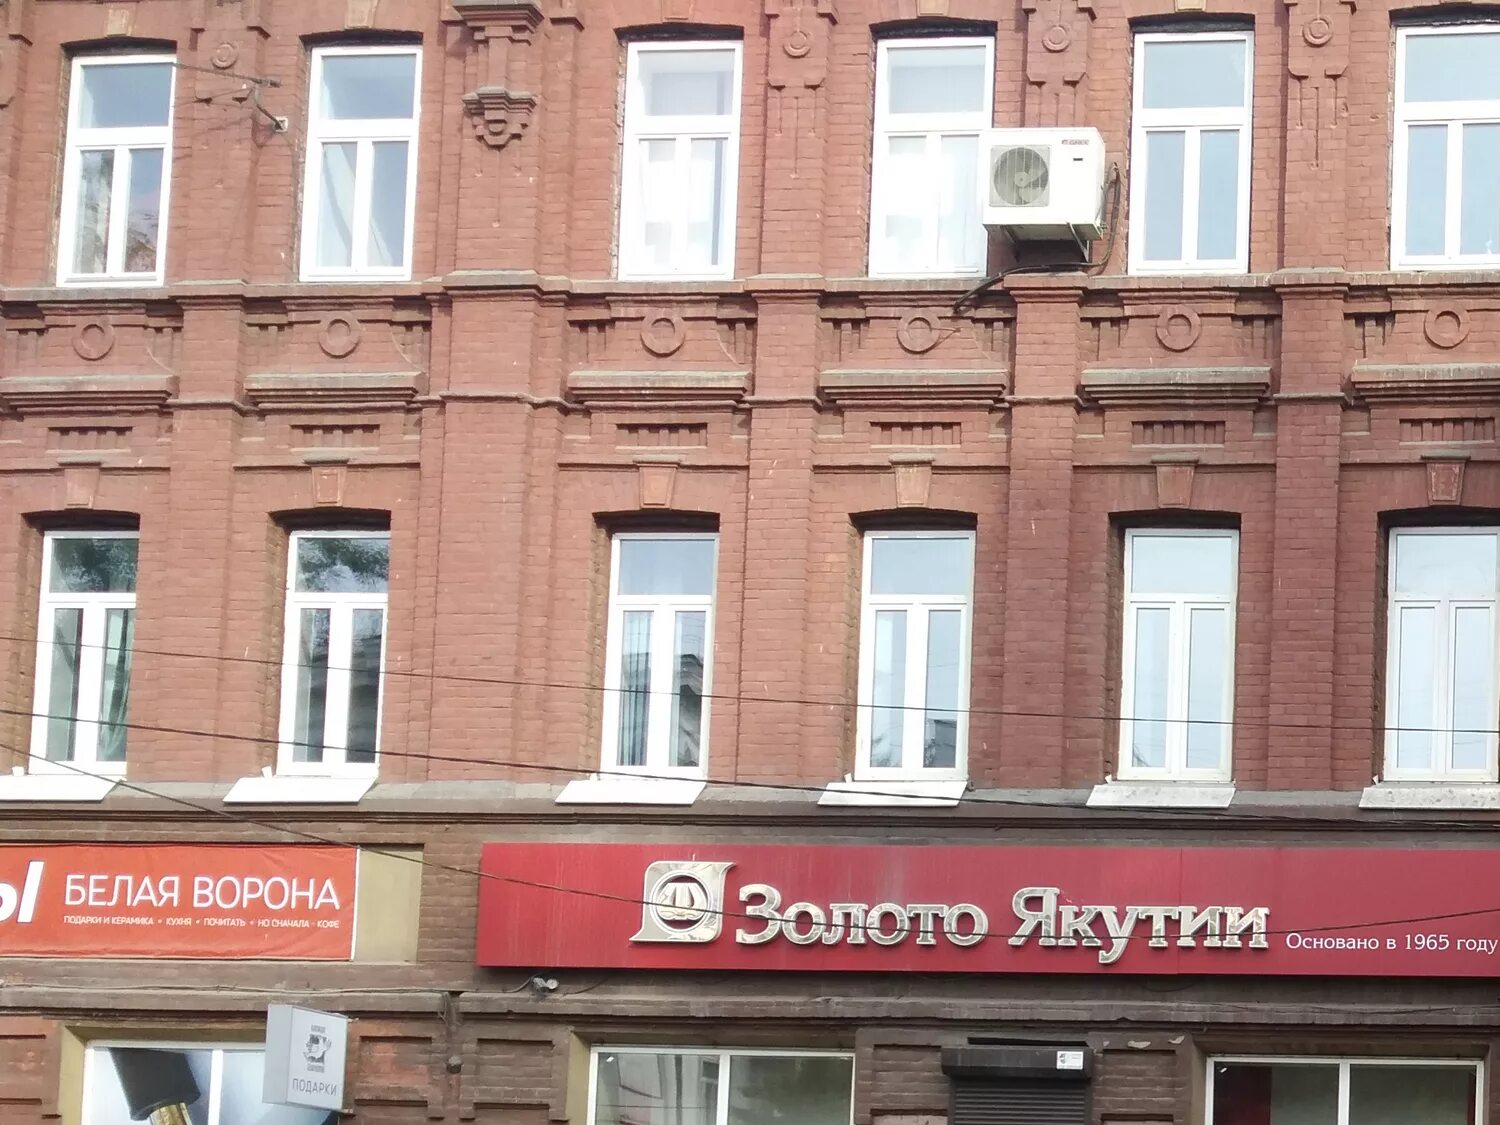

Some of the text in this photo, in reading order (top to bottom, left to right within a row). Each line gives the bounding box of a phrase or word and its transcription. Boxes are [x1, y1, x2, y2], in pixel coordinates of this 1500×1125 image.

[64, 874, 341, 910] БЕЛАЯ ВОРОНА
[63, 915, 340, 929] ПОДАРКИ И КЕРАМИКА КУХНЯ ПОЧИТАТЬ НО СНАЧАЛА КОФЕ
[736, 883, 1270, 964] Золото Якутии
[1285, 932, 1499, 955] Основано в 1965 году
[292, 1078, 337, 1096] ПОДАРКИ
